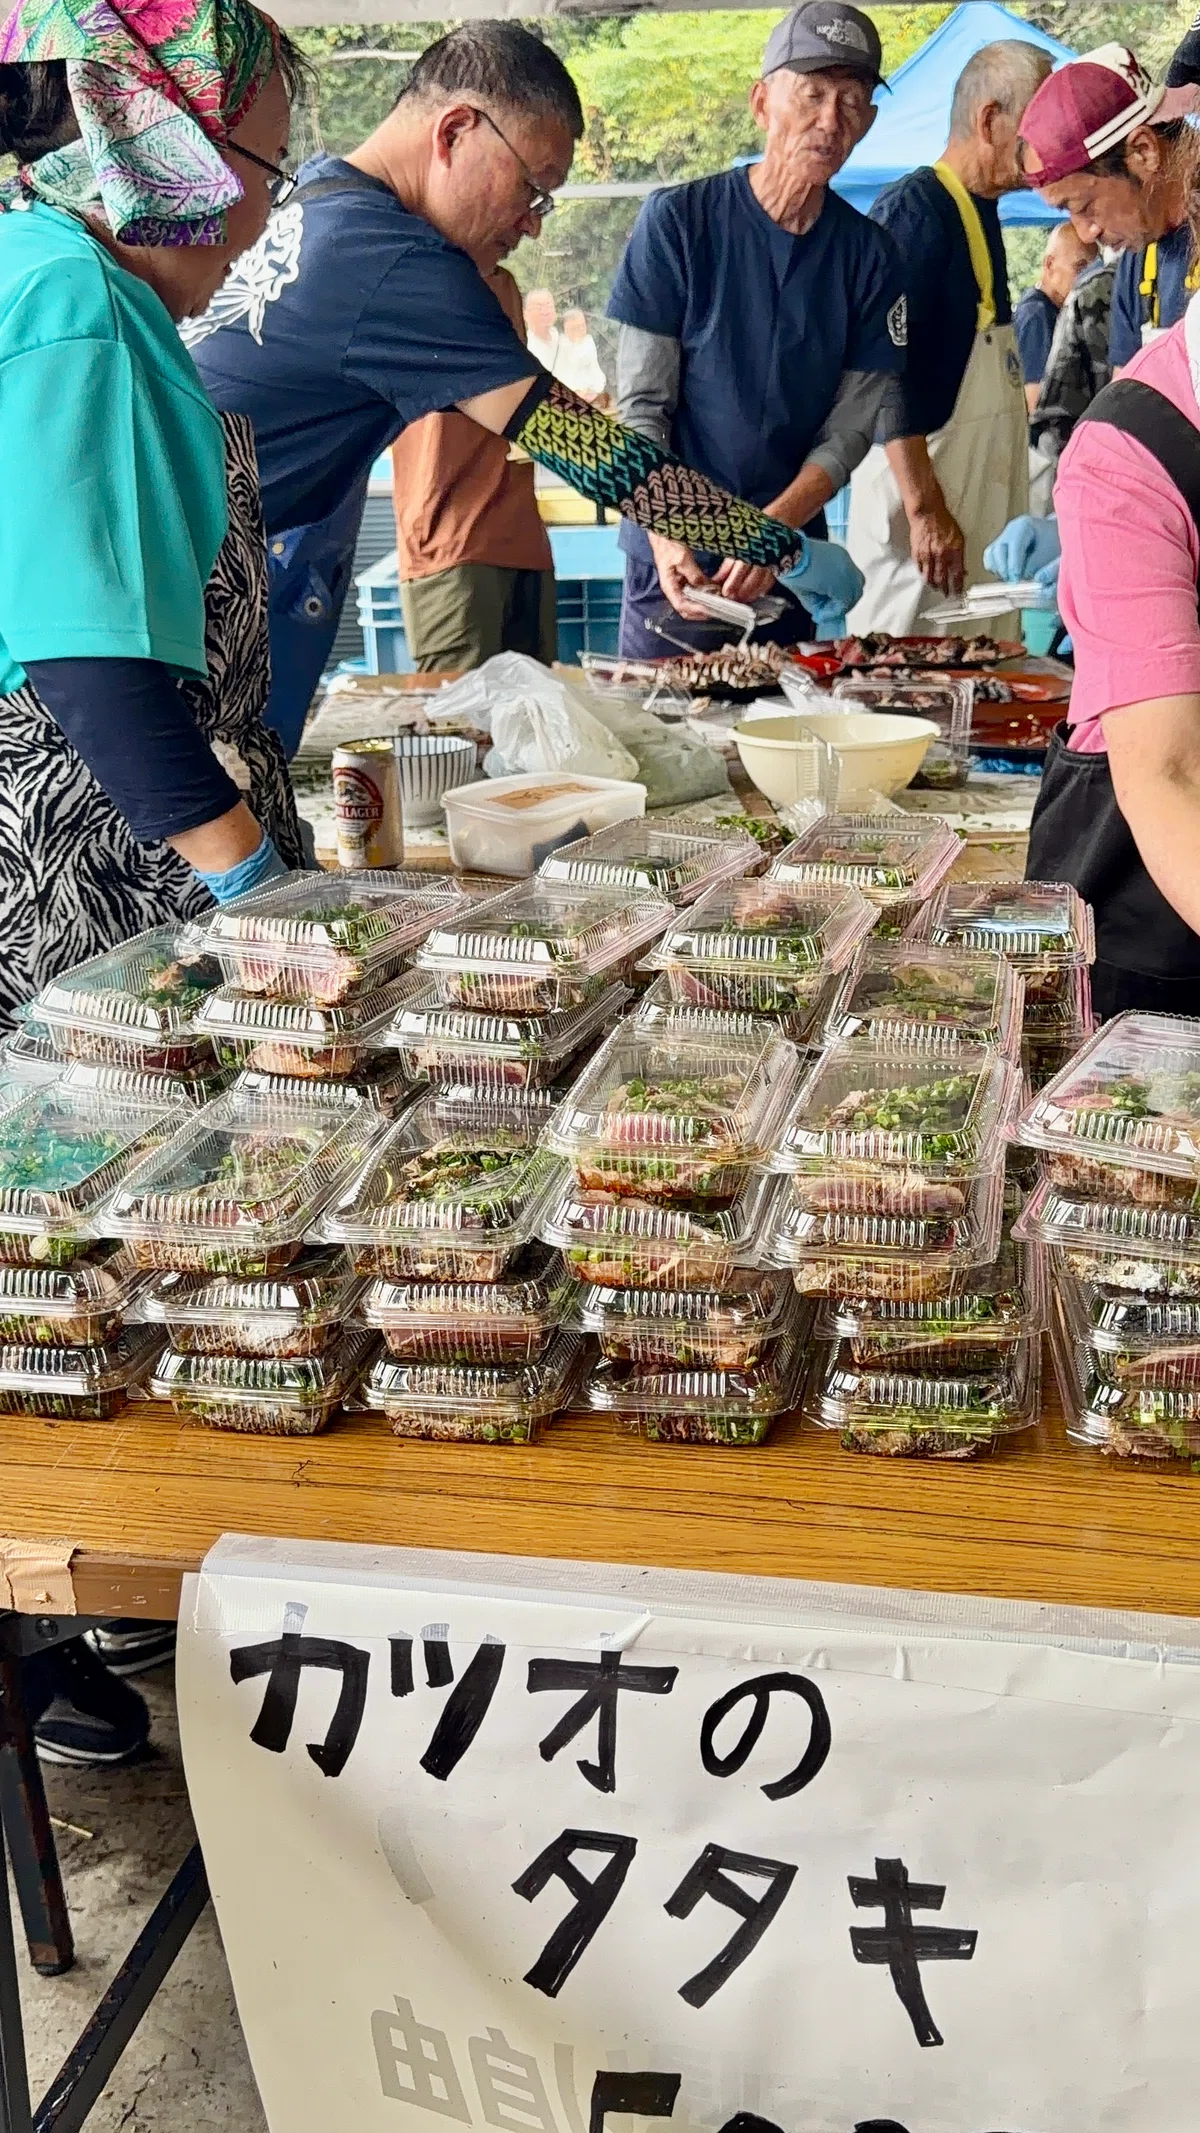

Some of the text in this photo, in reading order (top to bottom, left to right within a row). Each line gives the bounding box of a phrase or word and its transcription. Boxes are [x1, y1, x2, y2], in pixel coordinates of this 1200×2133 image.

[229, 1601, 832, 1801] カツオの
[510, 1828, 979, 2048] タタキ
